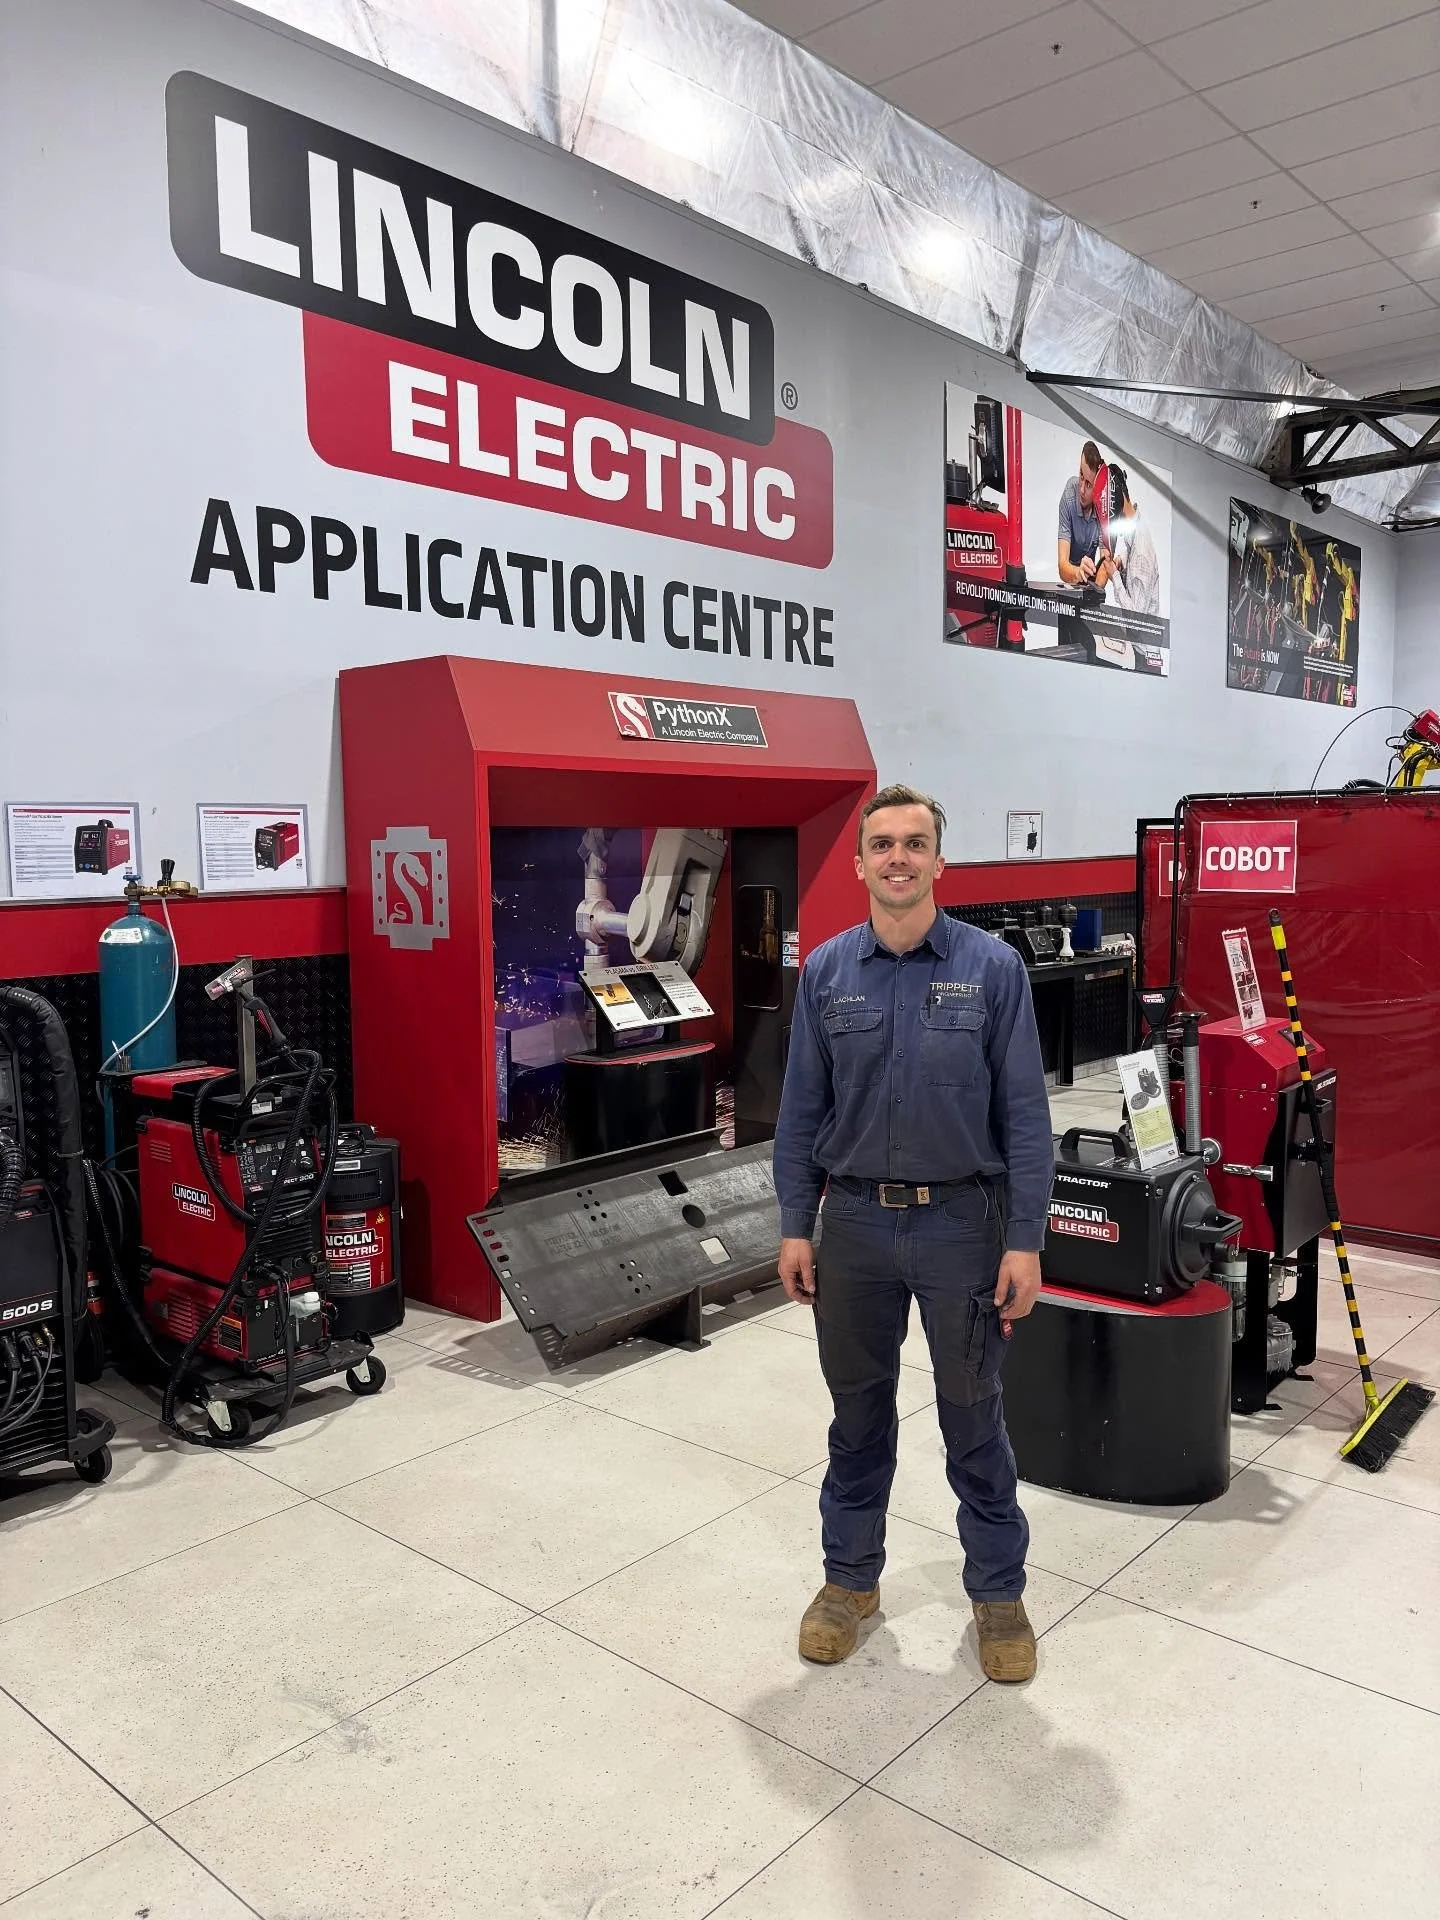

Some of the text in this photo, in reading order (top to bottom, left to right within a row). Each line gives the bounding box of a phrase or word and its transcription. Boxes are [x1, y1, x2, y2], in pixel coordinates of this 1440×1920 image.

[214, 114, 750, 420] LINCOLN
[388, 360, 796, 541] ELECTRIC
[947, 532, 993, 550] LINCOLN
[960, 552, 998, 565] ELECTRIC
[190, 497, 834, 668] APPLICATION CENTRE
[956, 580, 1076, 617] REVOLUTIONIZING WELDING TRAINING
[1233, 643, 1244, 658] The
[1261, 648, 1266, 662] is
[1266, 650, 1280, 665] NOW
[652, 701, 732, 727] PythonX
[662, 727, 759, 743] A Lincoln Electric Company
[1205, 846, 1291, 871] COBOT
[1168, 860, 1187, 882] B
[930, 982, 982, 994] TRIPPETT
[834, 995, 865, 1004] LACHLAN
[174, 1185, 207, 1205] LINCOLN
[182, 1201, 212, 1217] ELECTRIC
[325, 1231, 372, 1246] NCOLN
[1058, 1220, 1110, 1238] ELECTRIC
[326, 1244, 379, 1258] ELECTRIC
